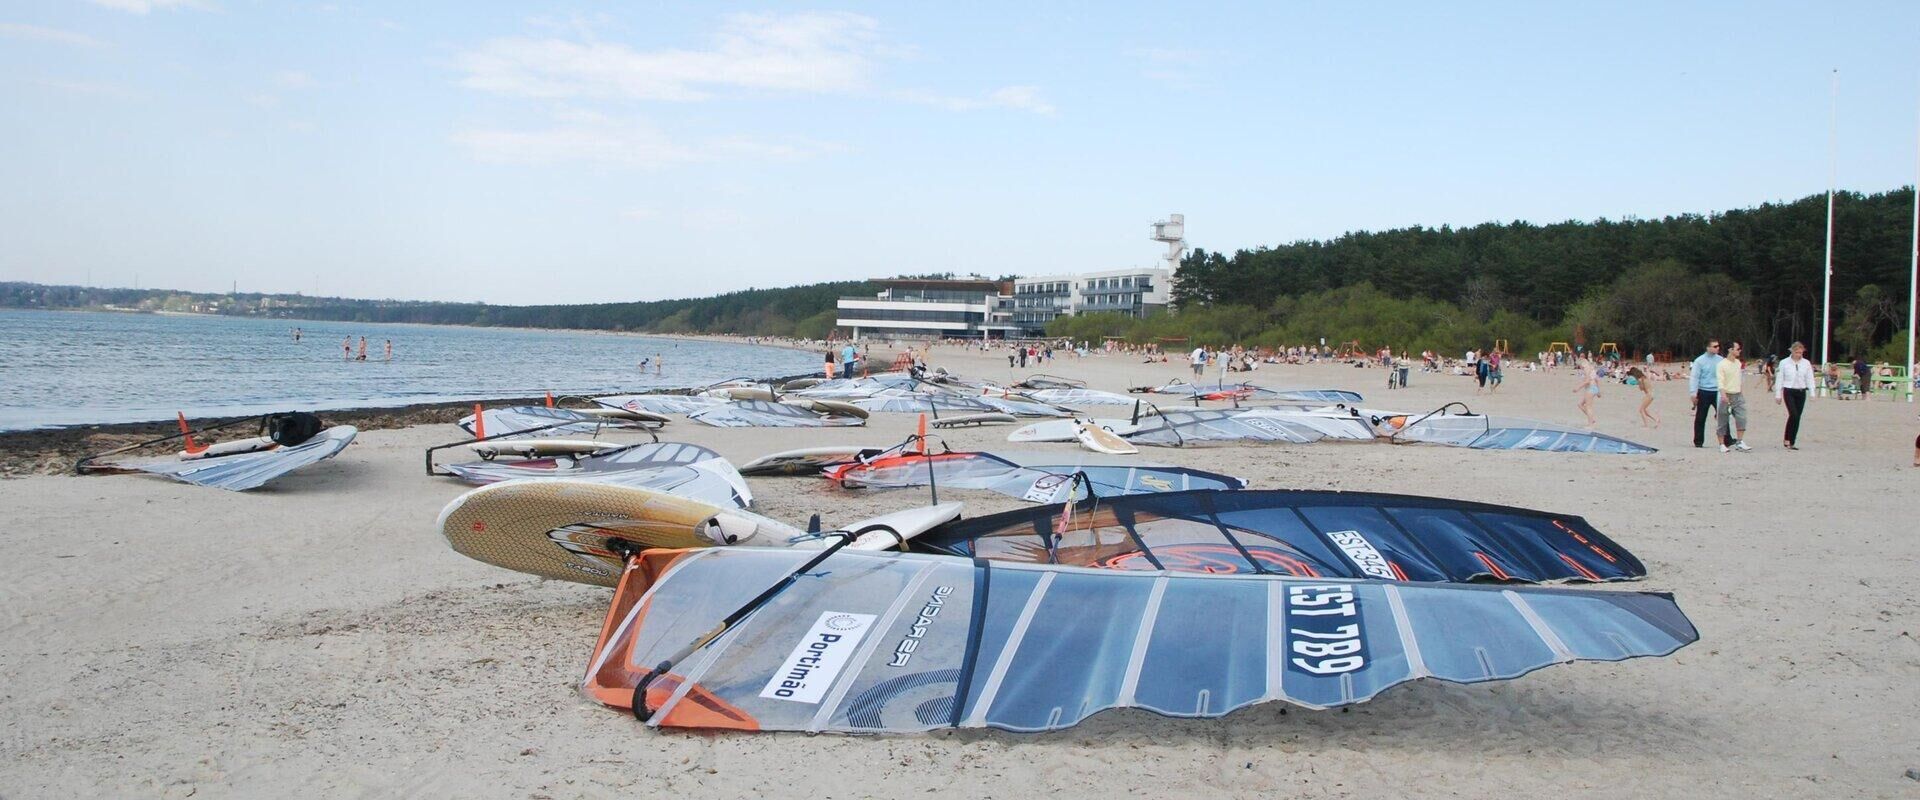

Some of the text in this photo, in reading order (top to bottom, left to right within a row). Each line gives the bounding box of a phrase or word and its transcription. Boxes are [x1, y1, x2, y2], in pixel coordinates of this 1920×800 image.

[1331, 531, 1392, 577] EST-345
[1290, 584, 1364, 674] EST 789
[774, 632, 842, 698] Portimão
